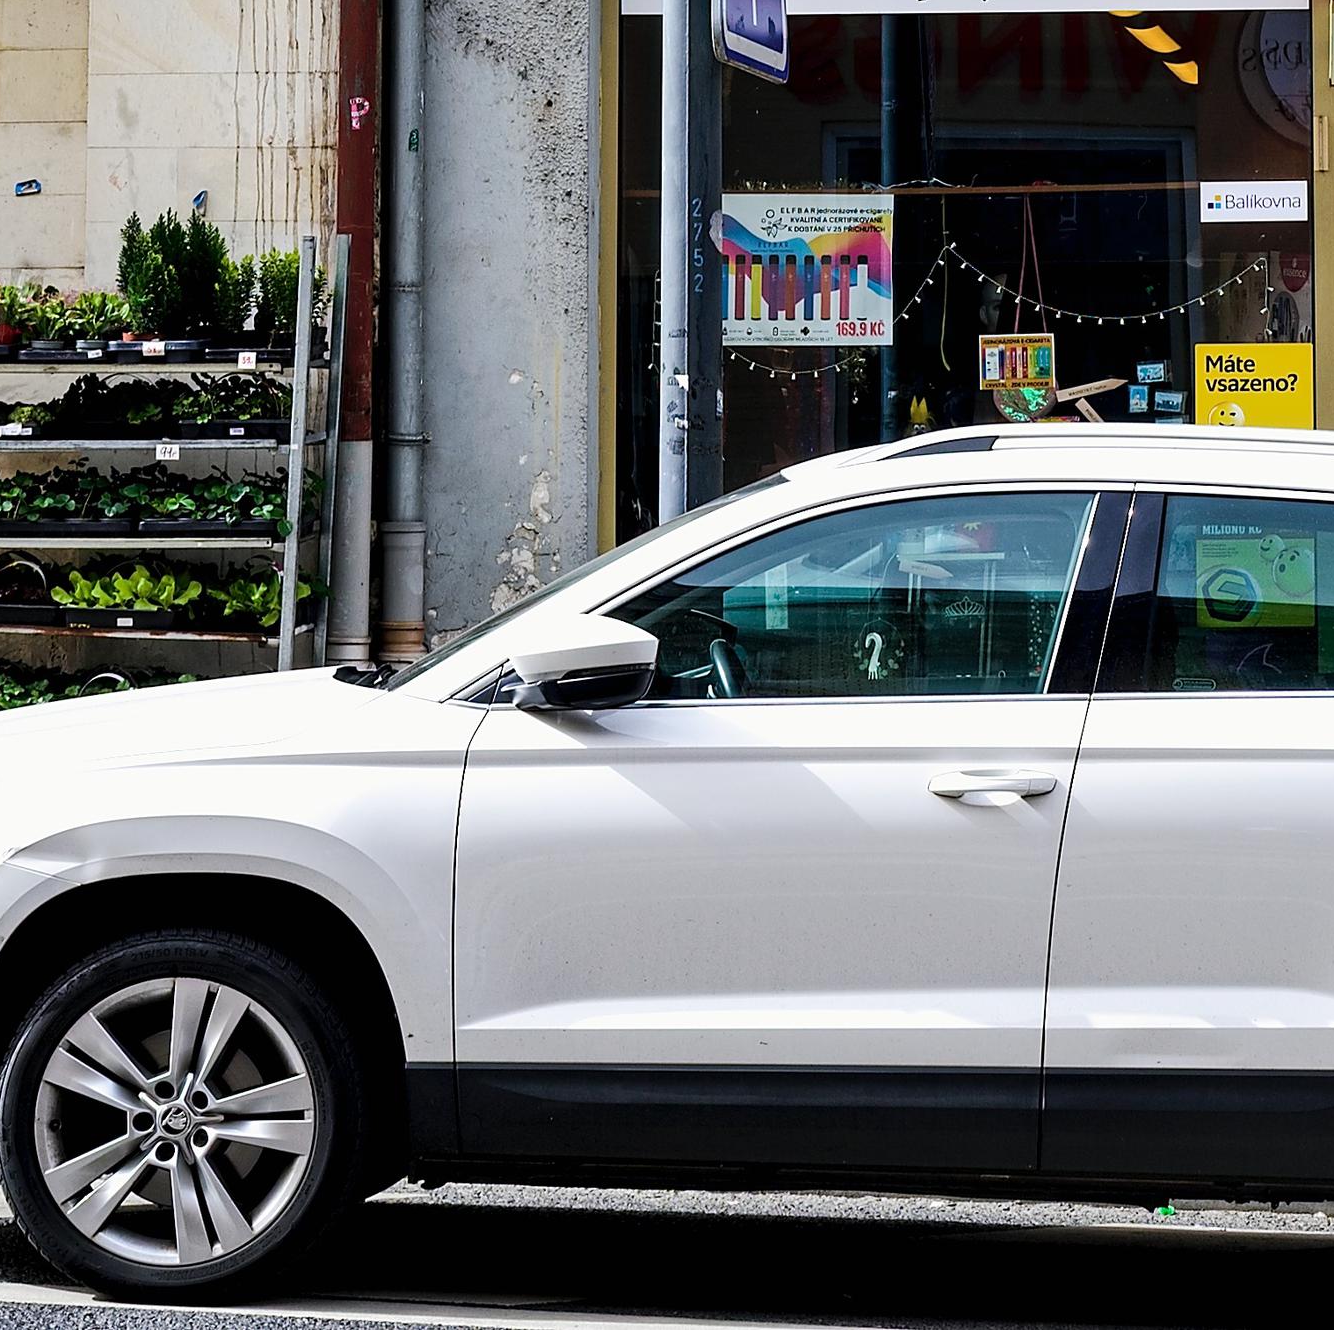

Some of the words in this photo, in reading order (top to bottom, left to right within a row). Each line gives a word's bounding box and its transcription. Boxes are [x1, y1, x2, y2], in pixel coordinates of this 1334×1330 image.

[1224, 193, 1302, 210] Balíkovna
[1205, 353, 1256, 373] Máte
[1205, 373, 1298, 392] vsazeno?
